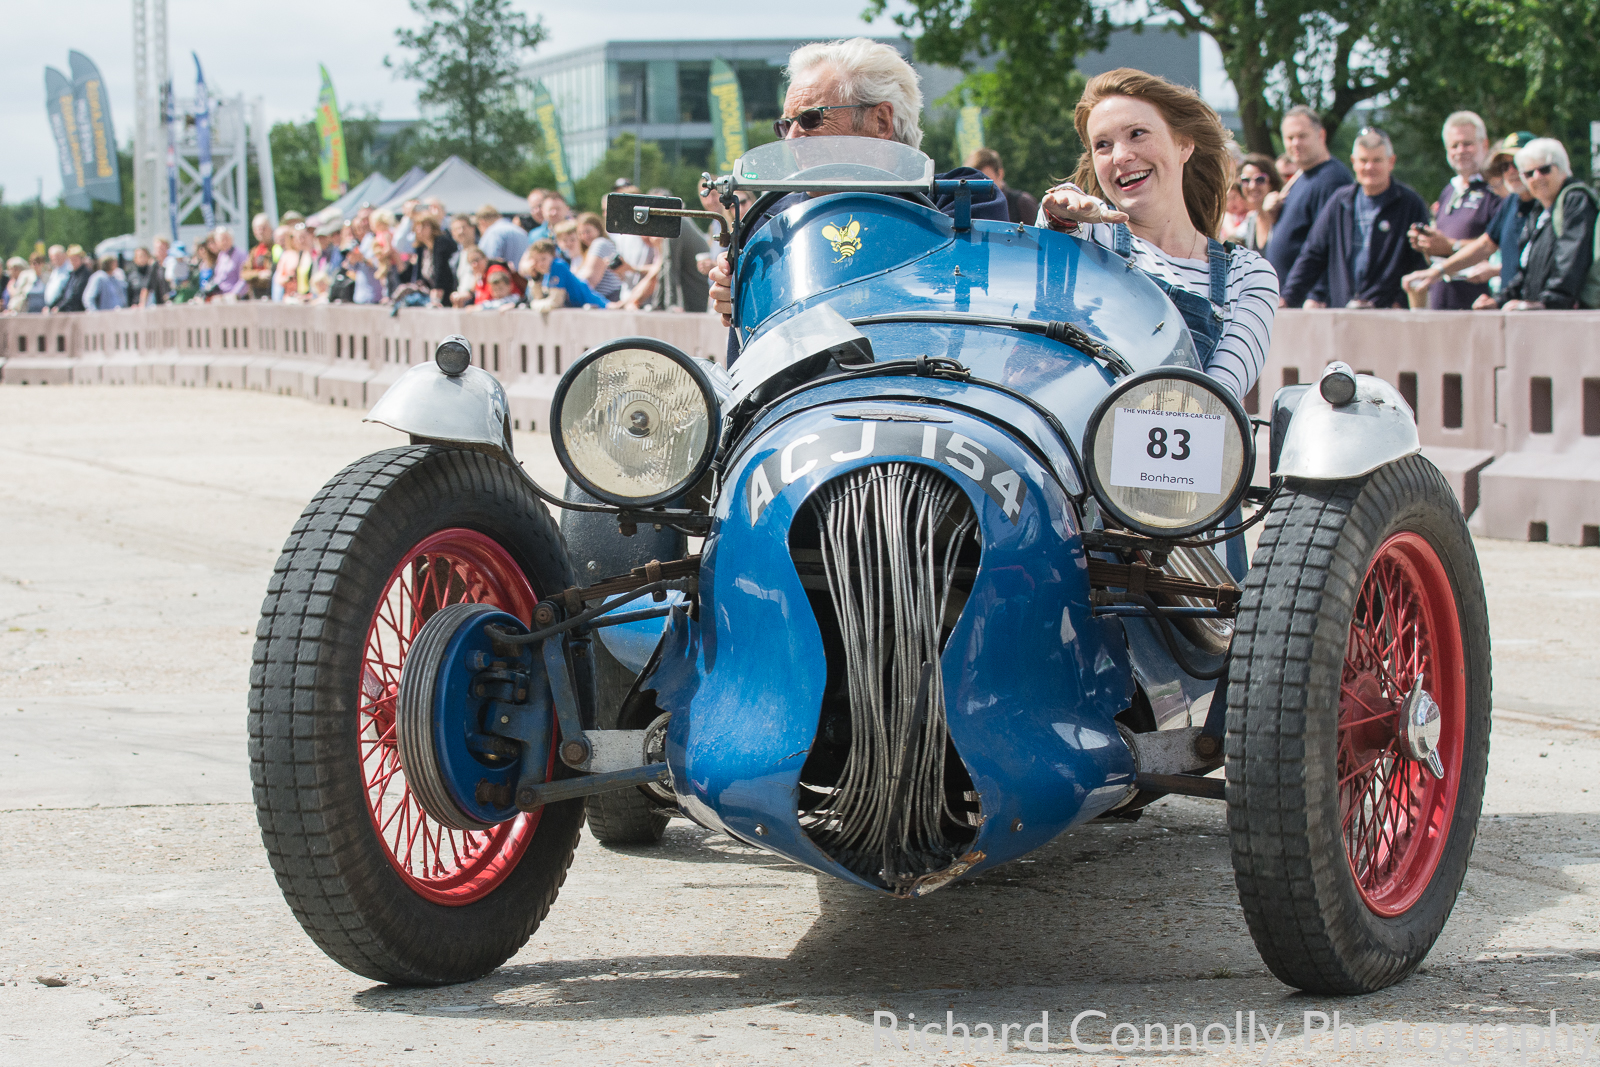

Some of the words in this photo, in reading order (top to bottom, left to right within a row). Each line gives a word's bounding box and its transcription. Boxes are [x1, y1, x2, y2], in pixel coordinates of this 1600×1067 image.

[1146, 427, 1191, 461] 83
[750, 422, 877, 527] ACJ
[921, 425, 1023, 519] 154
[1140, 472, 1195, 485] Bonhams
